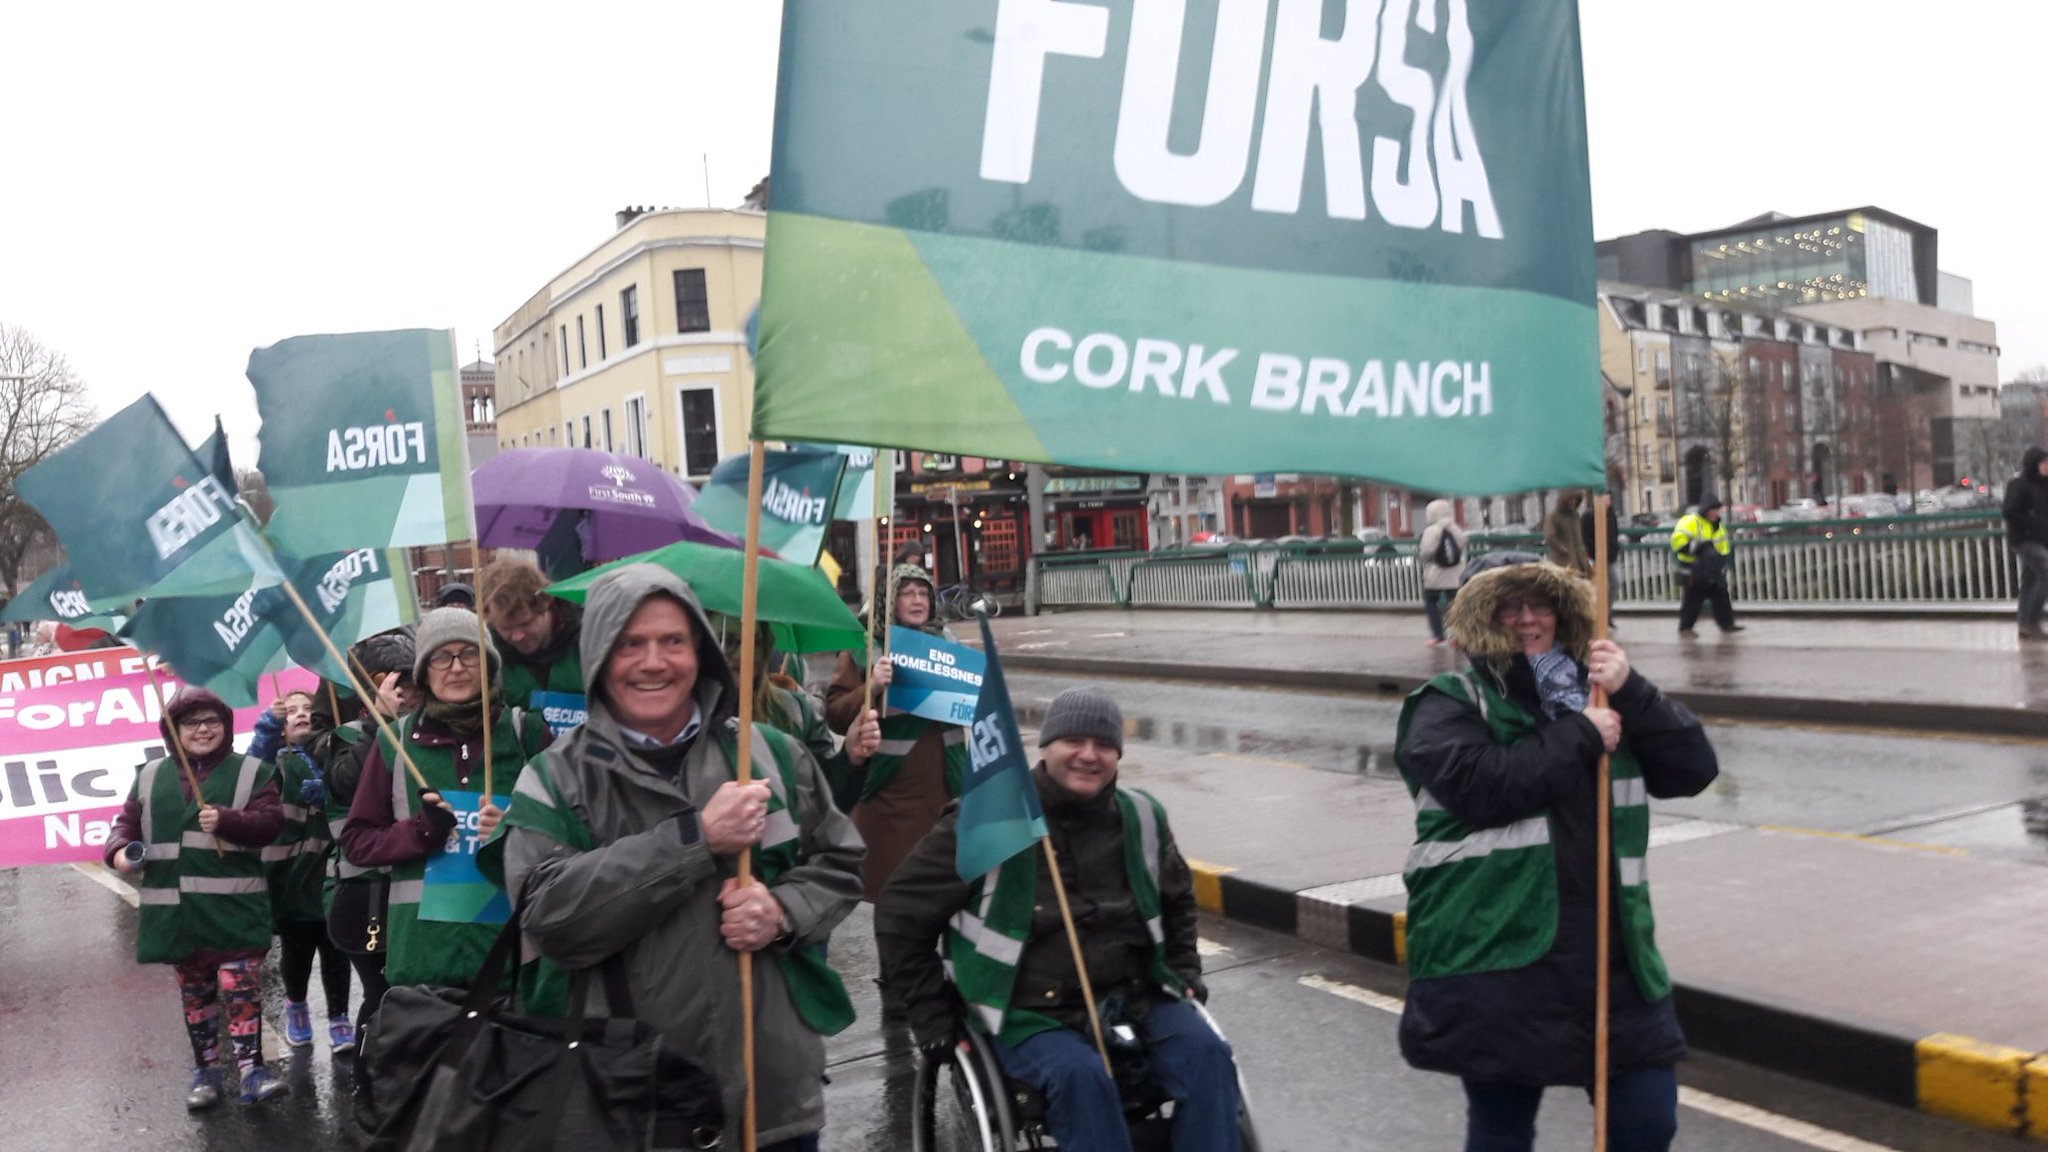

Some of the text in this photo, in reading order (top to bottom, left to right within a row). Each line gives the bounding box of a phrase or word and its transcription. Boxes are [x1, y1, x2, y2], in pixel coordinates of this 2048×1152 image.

[1019, 326, 1494, 418] CORK BRANCH
[929, 648, 955, 666] END
